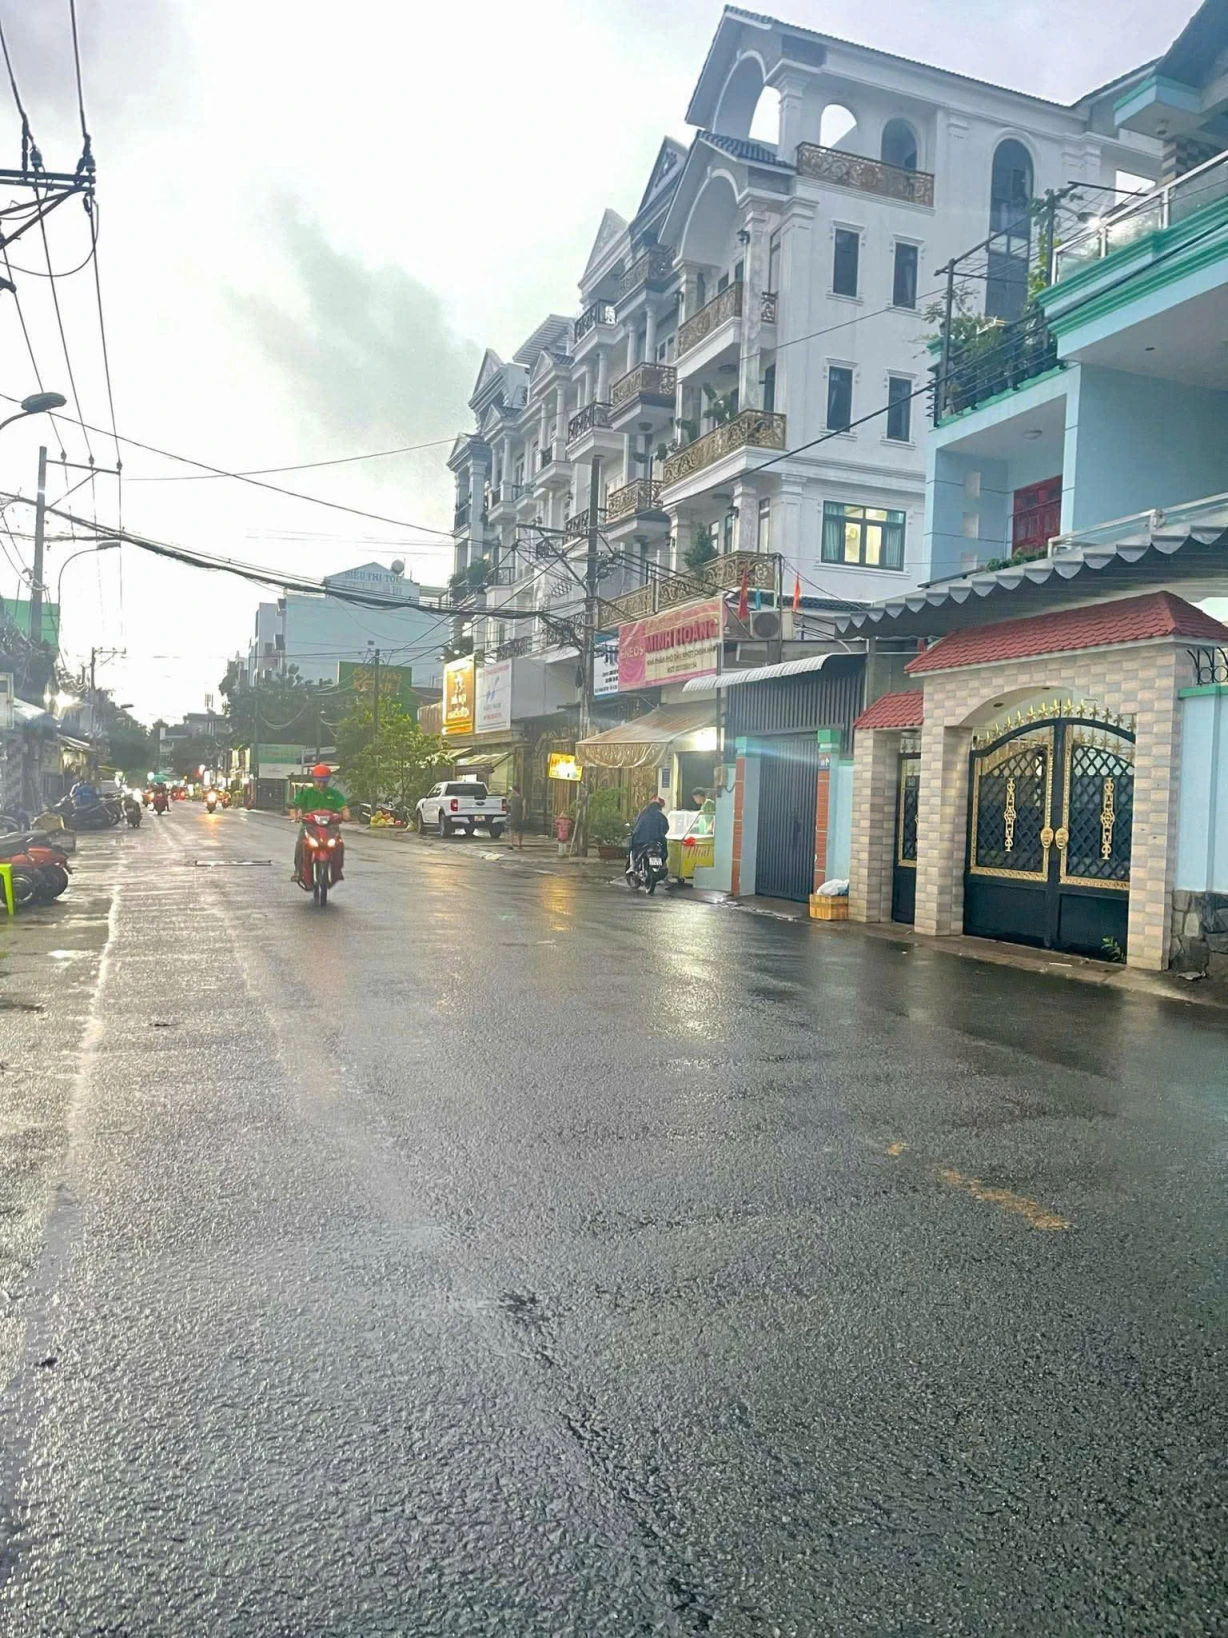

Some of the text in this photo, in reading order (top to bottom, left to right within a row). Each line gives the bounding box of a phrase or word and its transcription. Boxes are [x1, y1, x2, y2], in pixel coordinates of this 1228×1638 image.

[645, 629, 673, 653] MINH
[674, 620, 718, 645] HOÀNG
[620, 646, 644, 660] ENEOS
